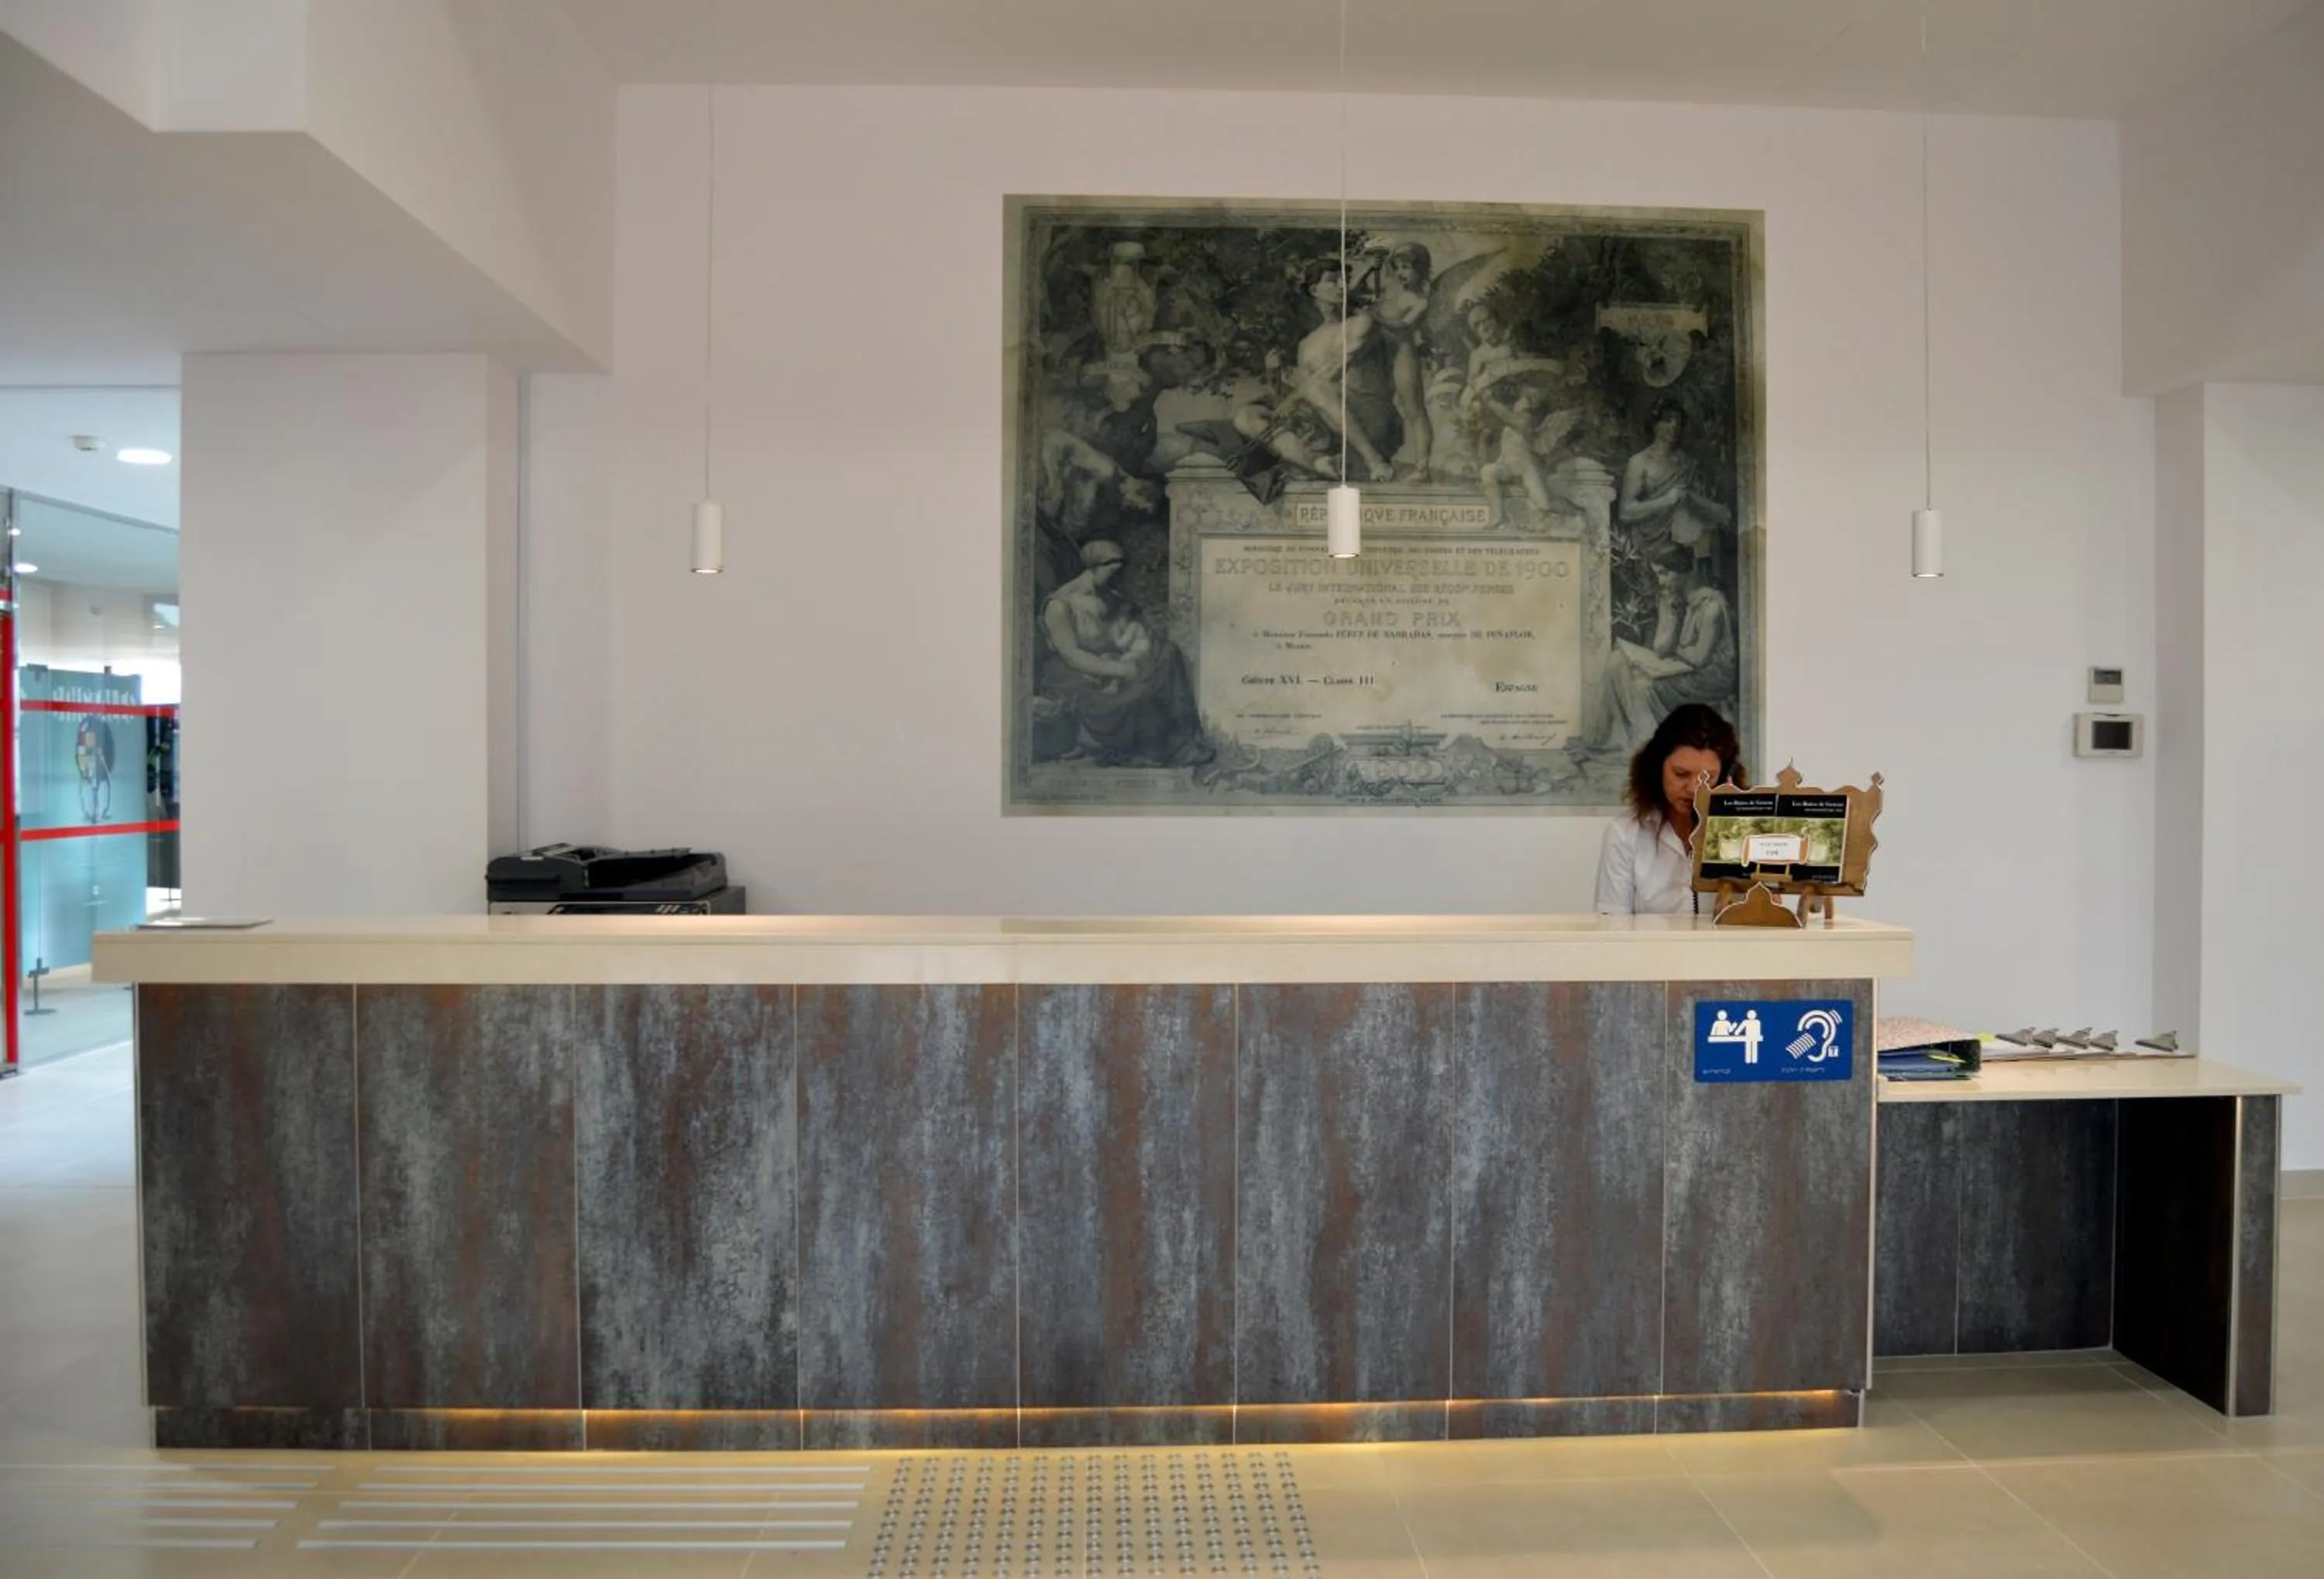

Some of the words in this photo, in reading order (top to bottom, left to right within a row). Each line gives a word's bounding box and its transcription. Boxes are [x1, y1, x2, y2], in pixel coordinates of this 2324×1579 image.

[1300, 506, 1394, 525] RÉPQVE
[1398, 508, 1487, 526] FRANÇAISE
[1215, 558, 1338, 576] EXPOSITION
[1347, 558, 1476, 576] UNIVERSELLE
[1485, 560, 1511, 577] DE
[1514, 560, 1570, 580] 1900
[1323, 611, 1399, 628] GRAND
[1412, 611, 1461, 628] PRIX
